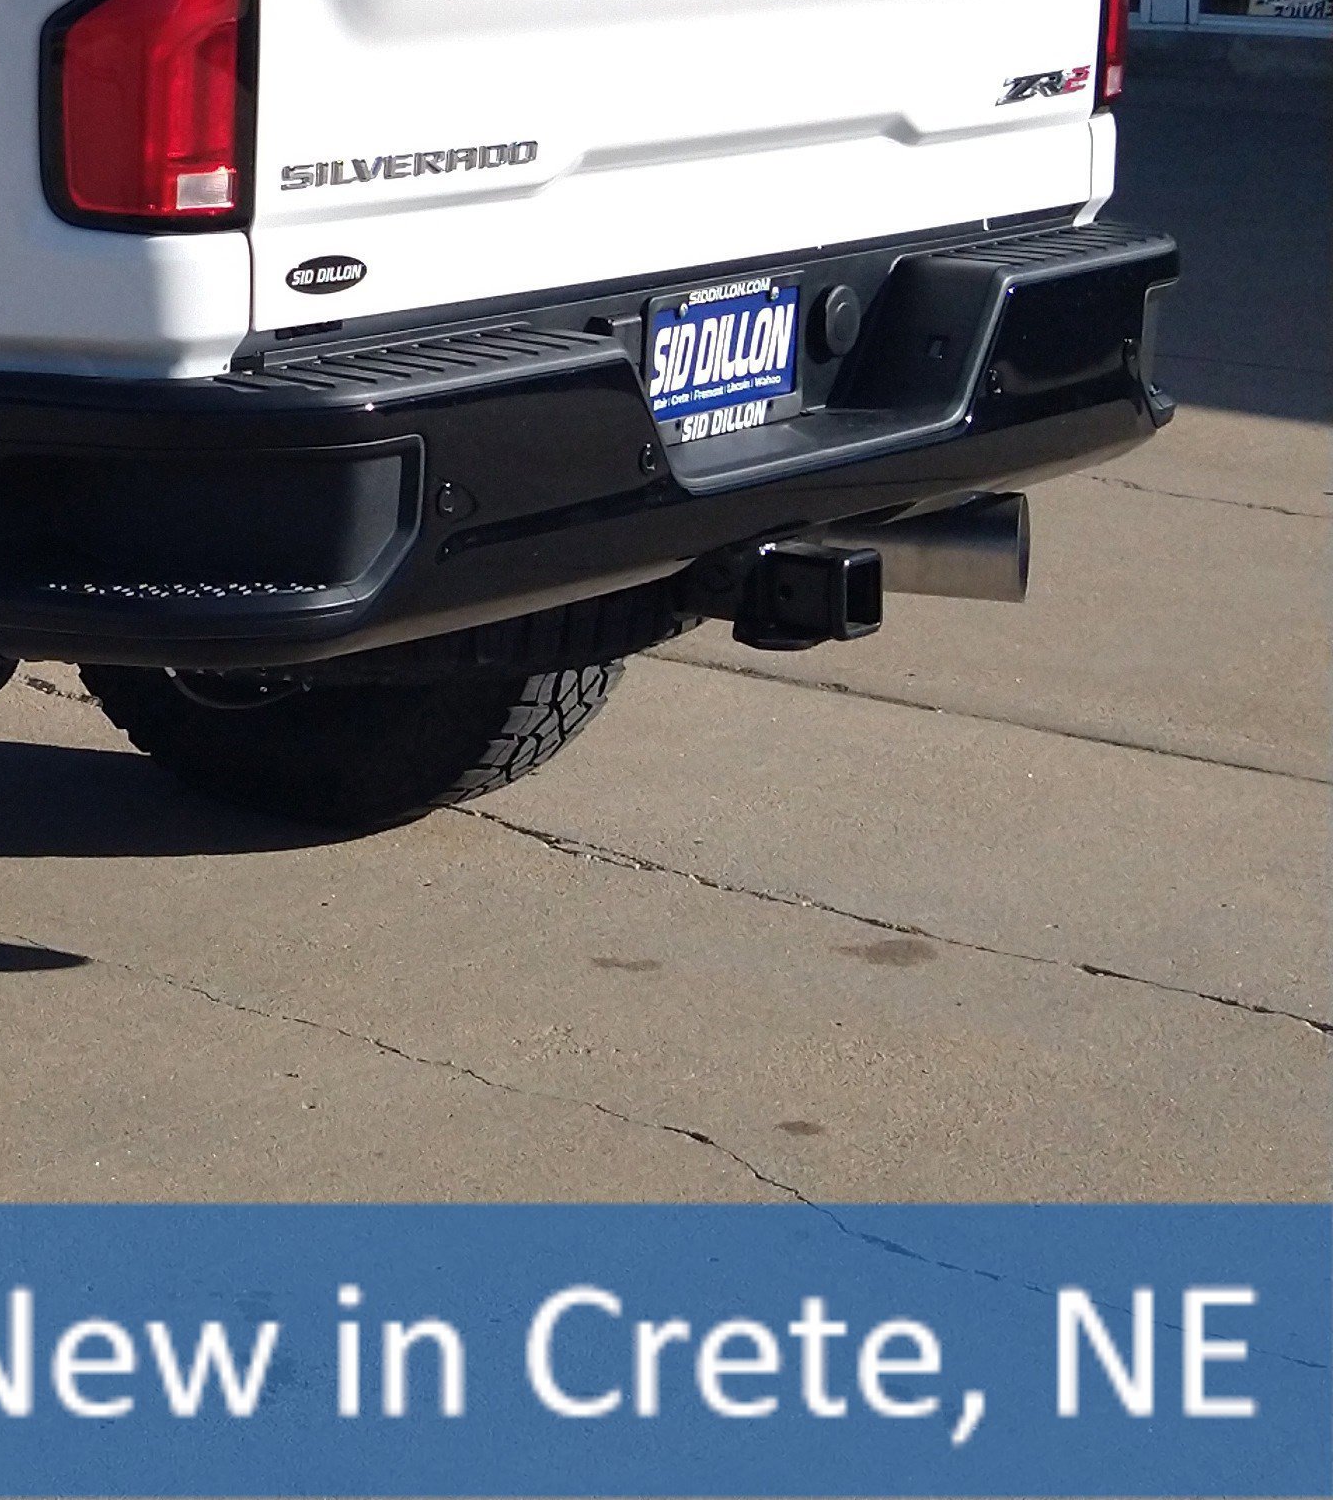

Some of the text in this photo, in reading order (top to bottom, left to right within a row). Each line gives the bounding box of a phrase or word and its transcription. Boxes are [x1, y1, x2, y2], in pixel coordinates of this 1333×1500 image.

[995, 65, 1091, 106] ZR2
[281, 140, 539, 191] SILVERADO
[291, 263, 363, 286] SID DILLON
[650, 303, 795, 397] SID DILLON
[681, 399, 768, 443] SID DILLON
